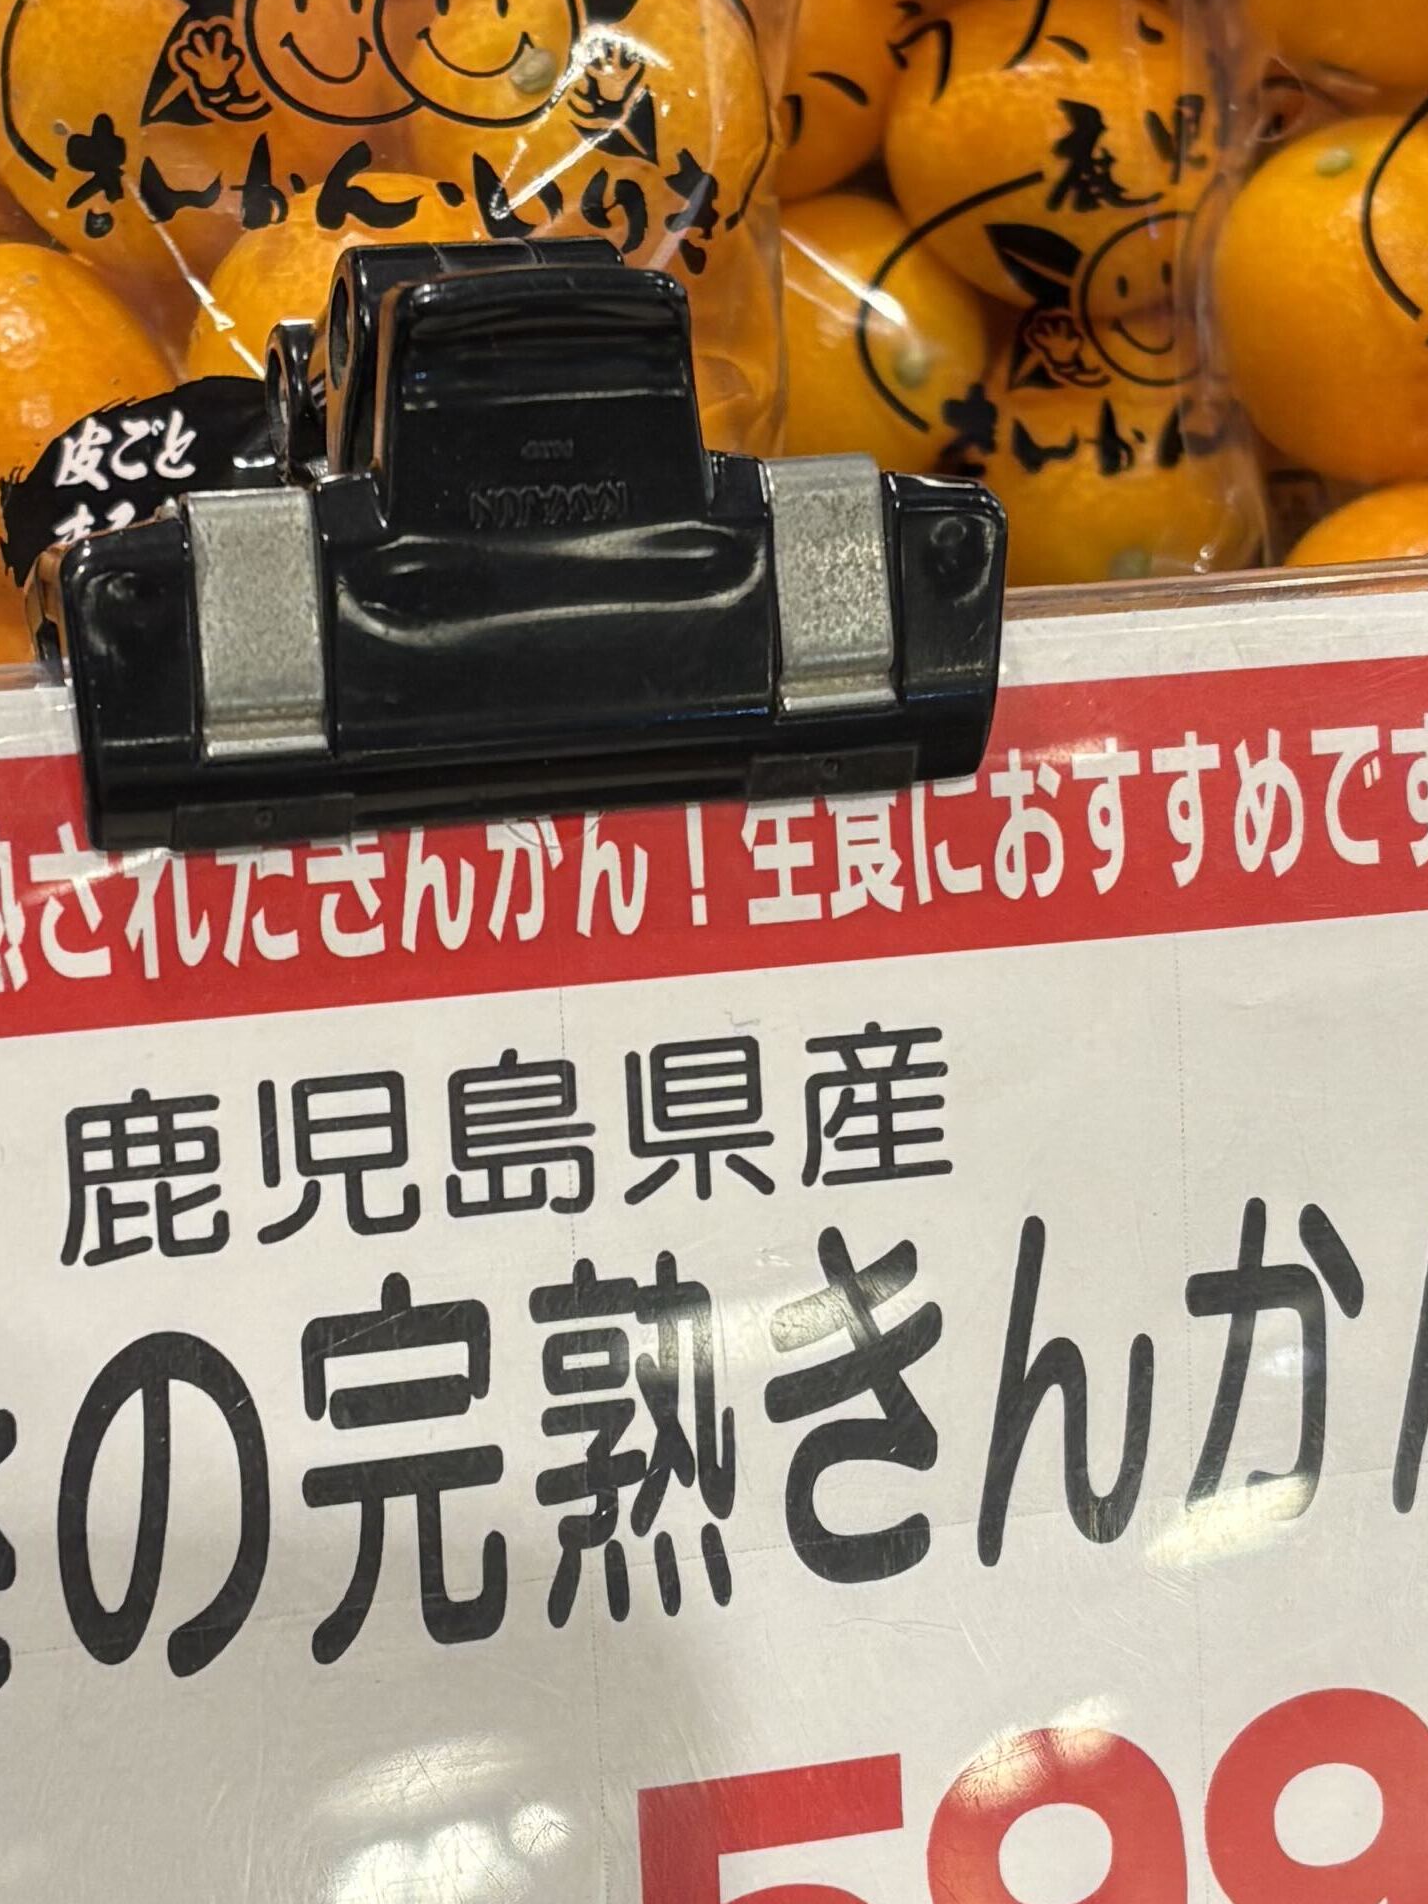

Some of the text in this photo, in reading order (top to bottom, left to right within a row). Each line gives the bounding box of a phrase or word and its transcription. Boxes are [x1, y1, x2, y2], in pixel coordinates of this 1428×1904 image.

[1046, 96, 1210, 213] 鹿児
[56, 409, 197, 491] 皮ごと
[59, 1021, 953, 1266] 鹿児島県産
